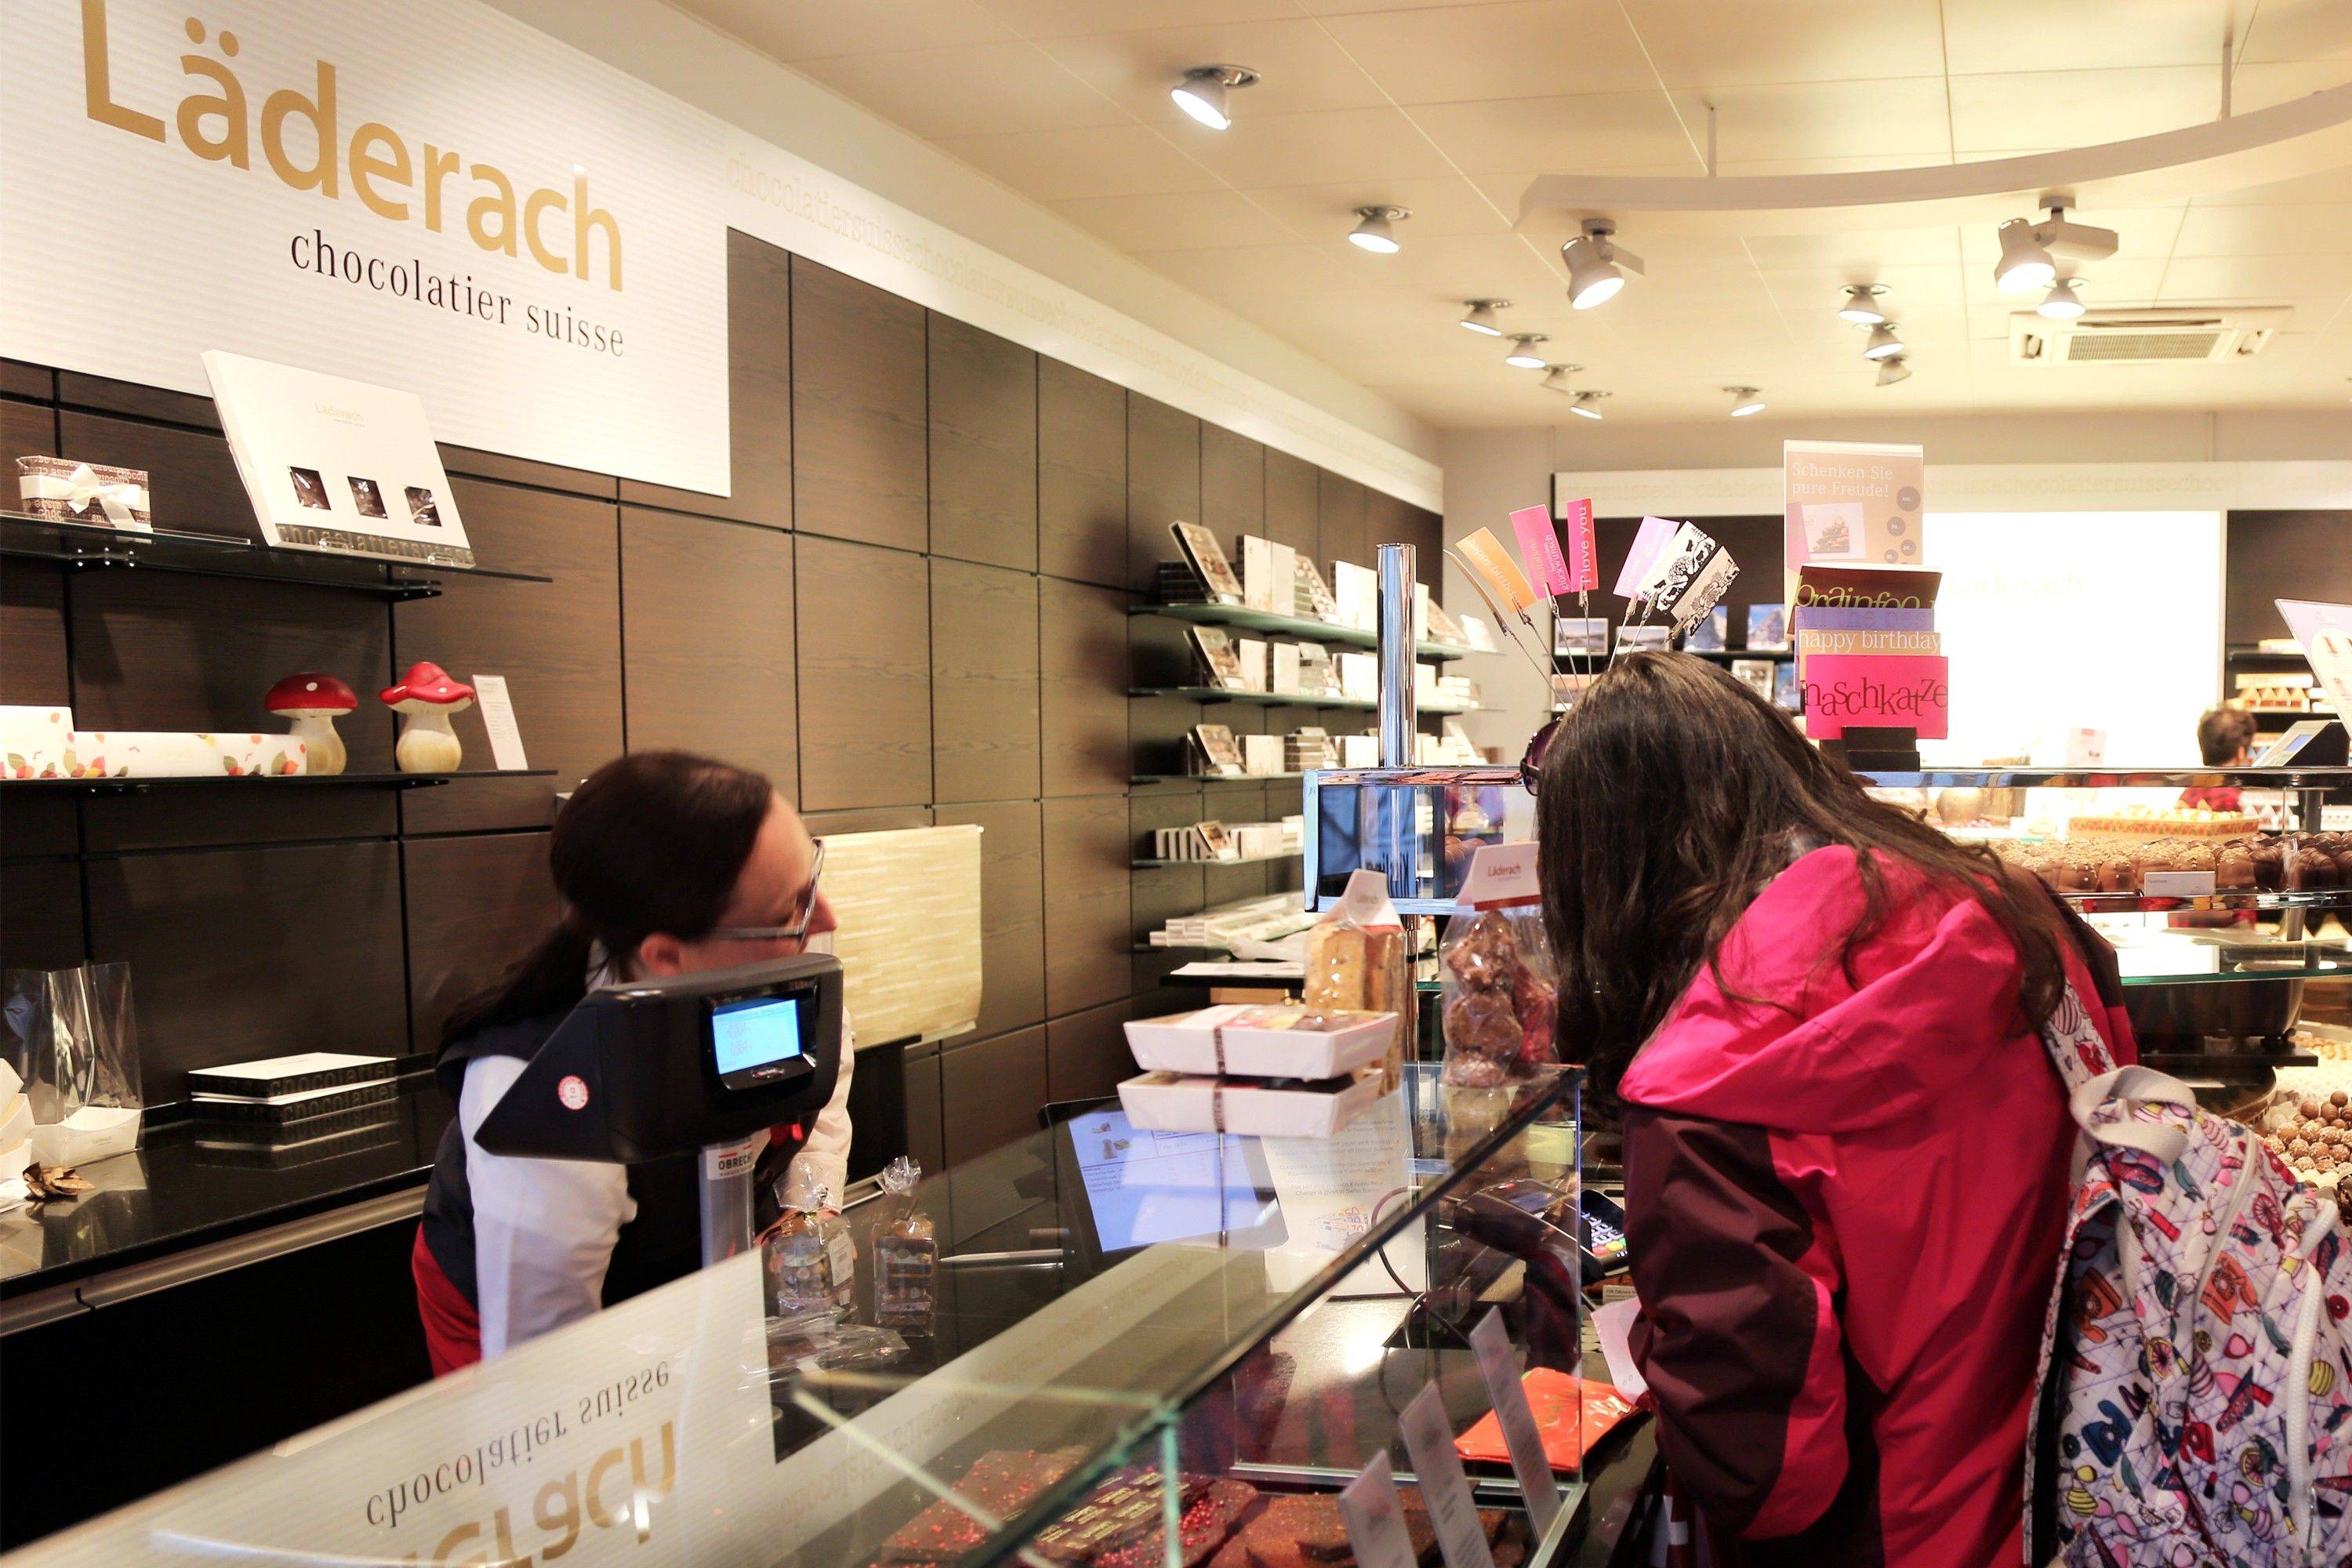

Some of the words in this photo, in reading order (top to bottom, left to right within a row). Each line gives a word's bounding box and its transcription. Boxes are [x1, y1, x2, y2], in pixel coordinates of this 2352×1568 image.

[82, 0, 624, 292] Läderach
[290, 228, 512, 326] chocolatier
[525, 302, 625, 358] suisse
[1791, 461, 1865, 480] Schenken
[1870, 465, 1895, 481] Sie
[1792, 482, 1826, 497] pure
[1831, 481, 1889, 498] Freude!
[1579, 506, 1591, 535] you
[1581, 539, 1592, 574] love
[1799, 630, 1856, 653] happy
[1862, 630, 1941, 654] birthday
[1806, 677, 1948, 717] naschkatze
